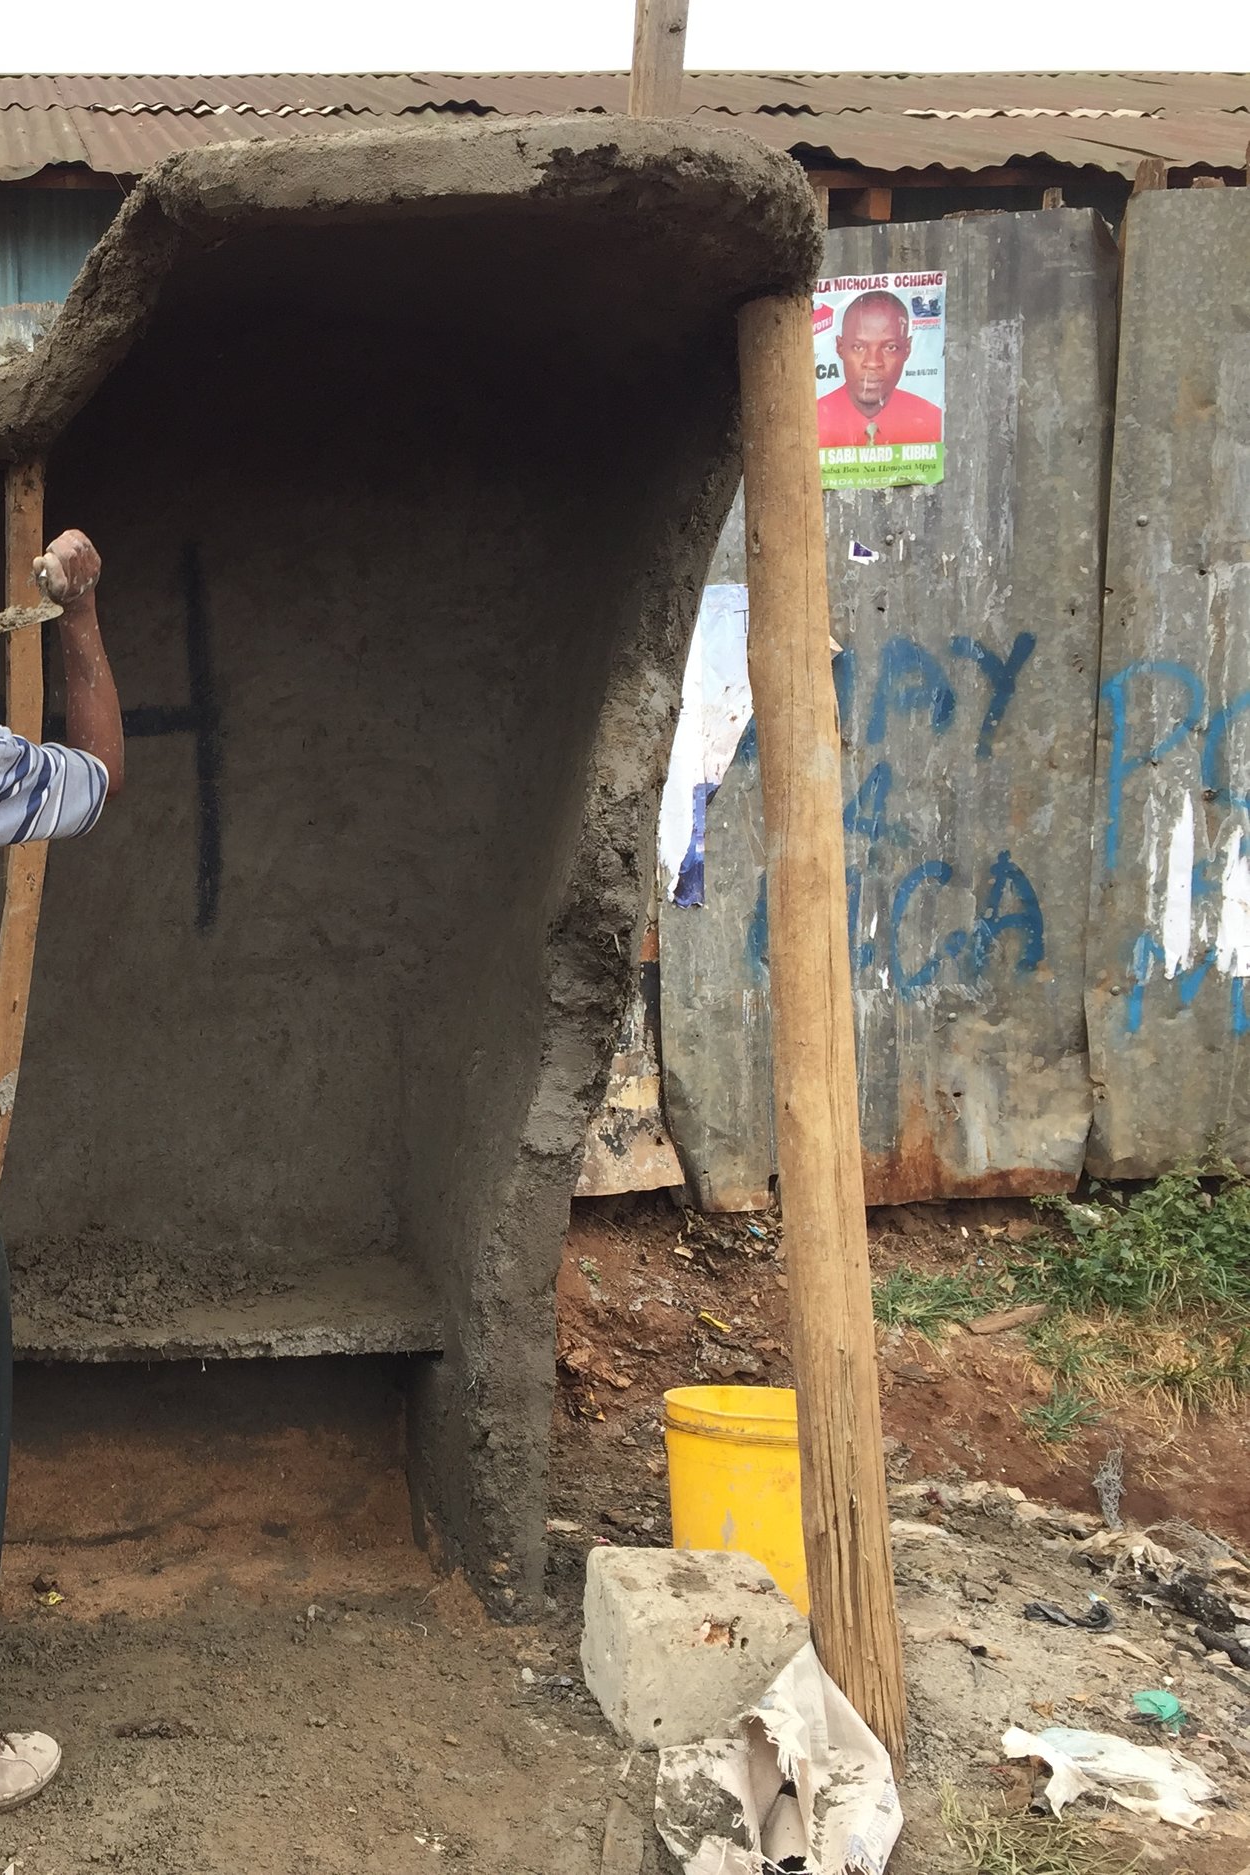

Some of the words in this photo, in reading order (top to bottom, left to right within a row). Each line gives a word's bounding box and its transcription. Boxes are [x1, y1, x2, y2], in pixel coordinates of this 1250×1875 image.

[834, 276, 889, 291] NICHOLAS
[894, 273, 943, 288] OCHIENG
[828, 448, 858, 464] SABA
[859, 446, 893, 462] WARD
[902, 444, 937, 460] KIBRA
